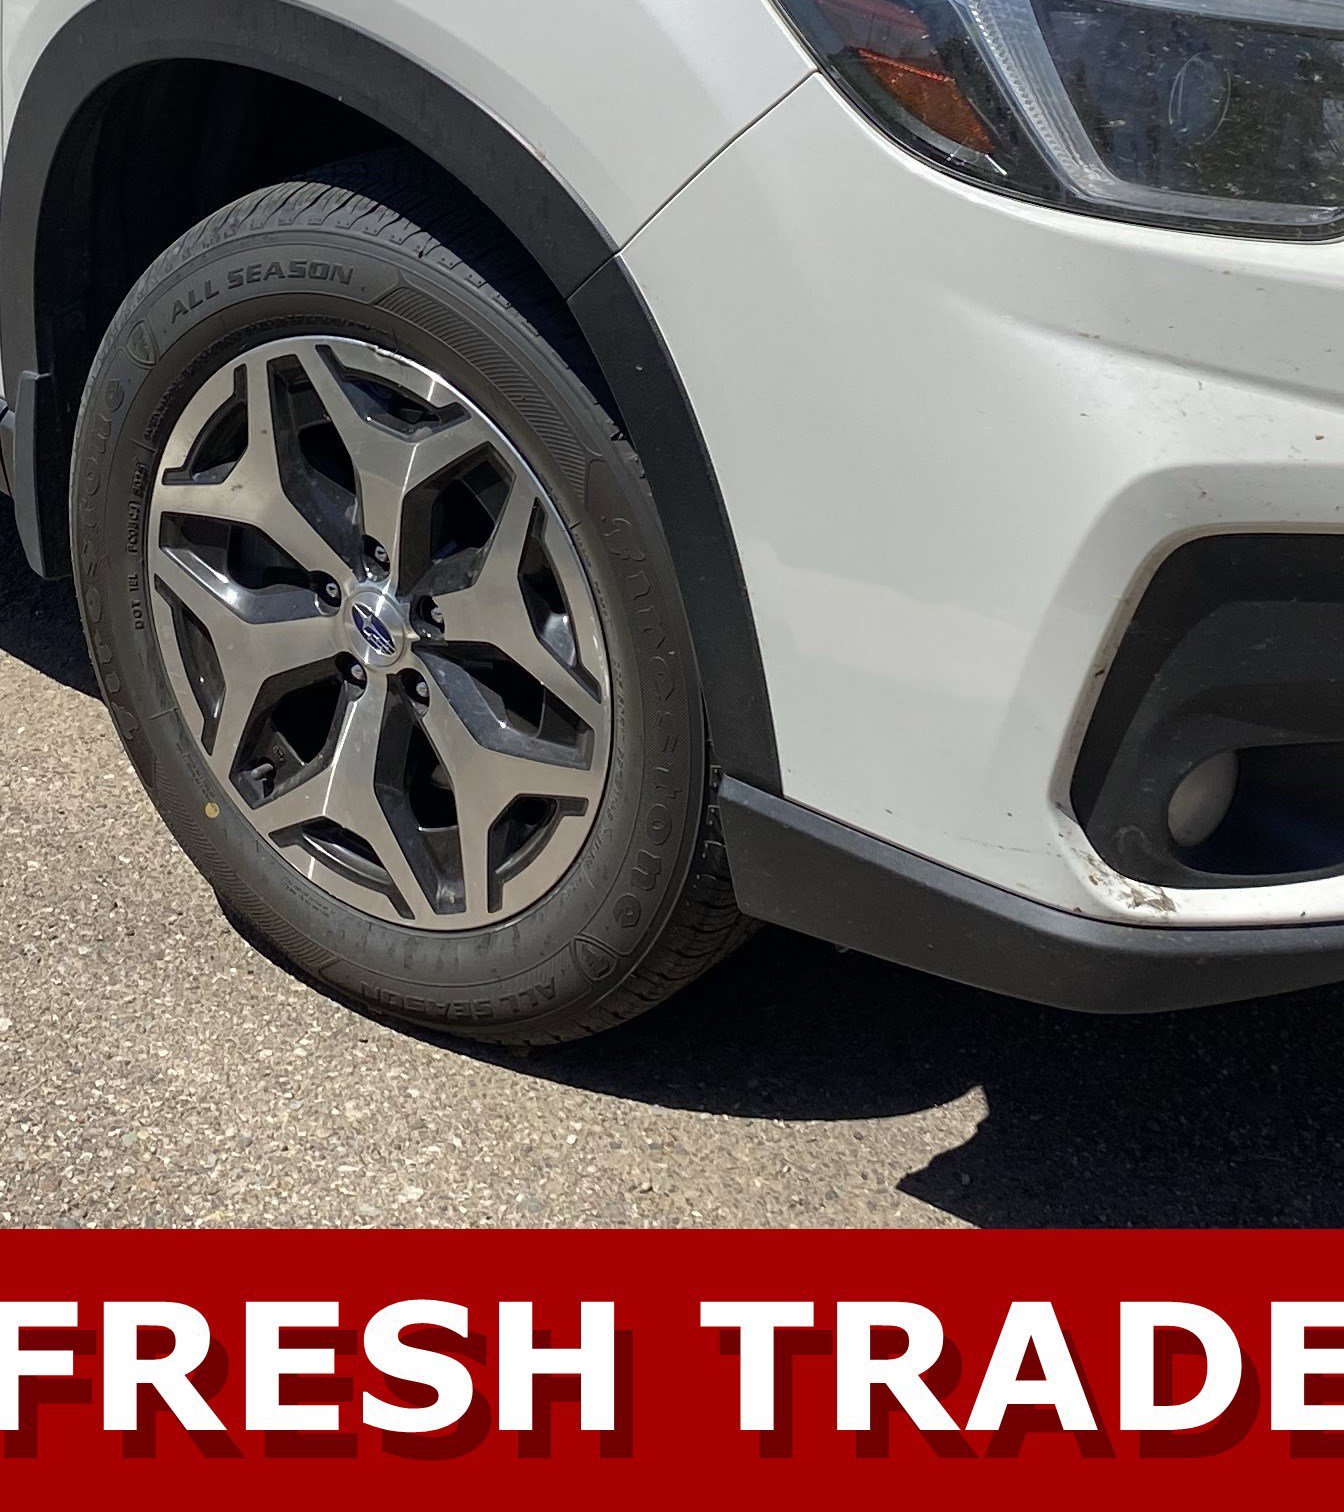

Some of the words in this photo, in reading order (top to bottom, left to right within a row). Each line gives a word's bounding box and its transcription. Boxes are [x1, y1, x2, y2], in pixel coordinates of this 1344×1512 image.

[171, 279, 220, 324] ALL
[227, 260, 354, 290] SEASON
[131, 599, 146, 630] DOT
[499, 976, 556, 1014] ALL
